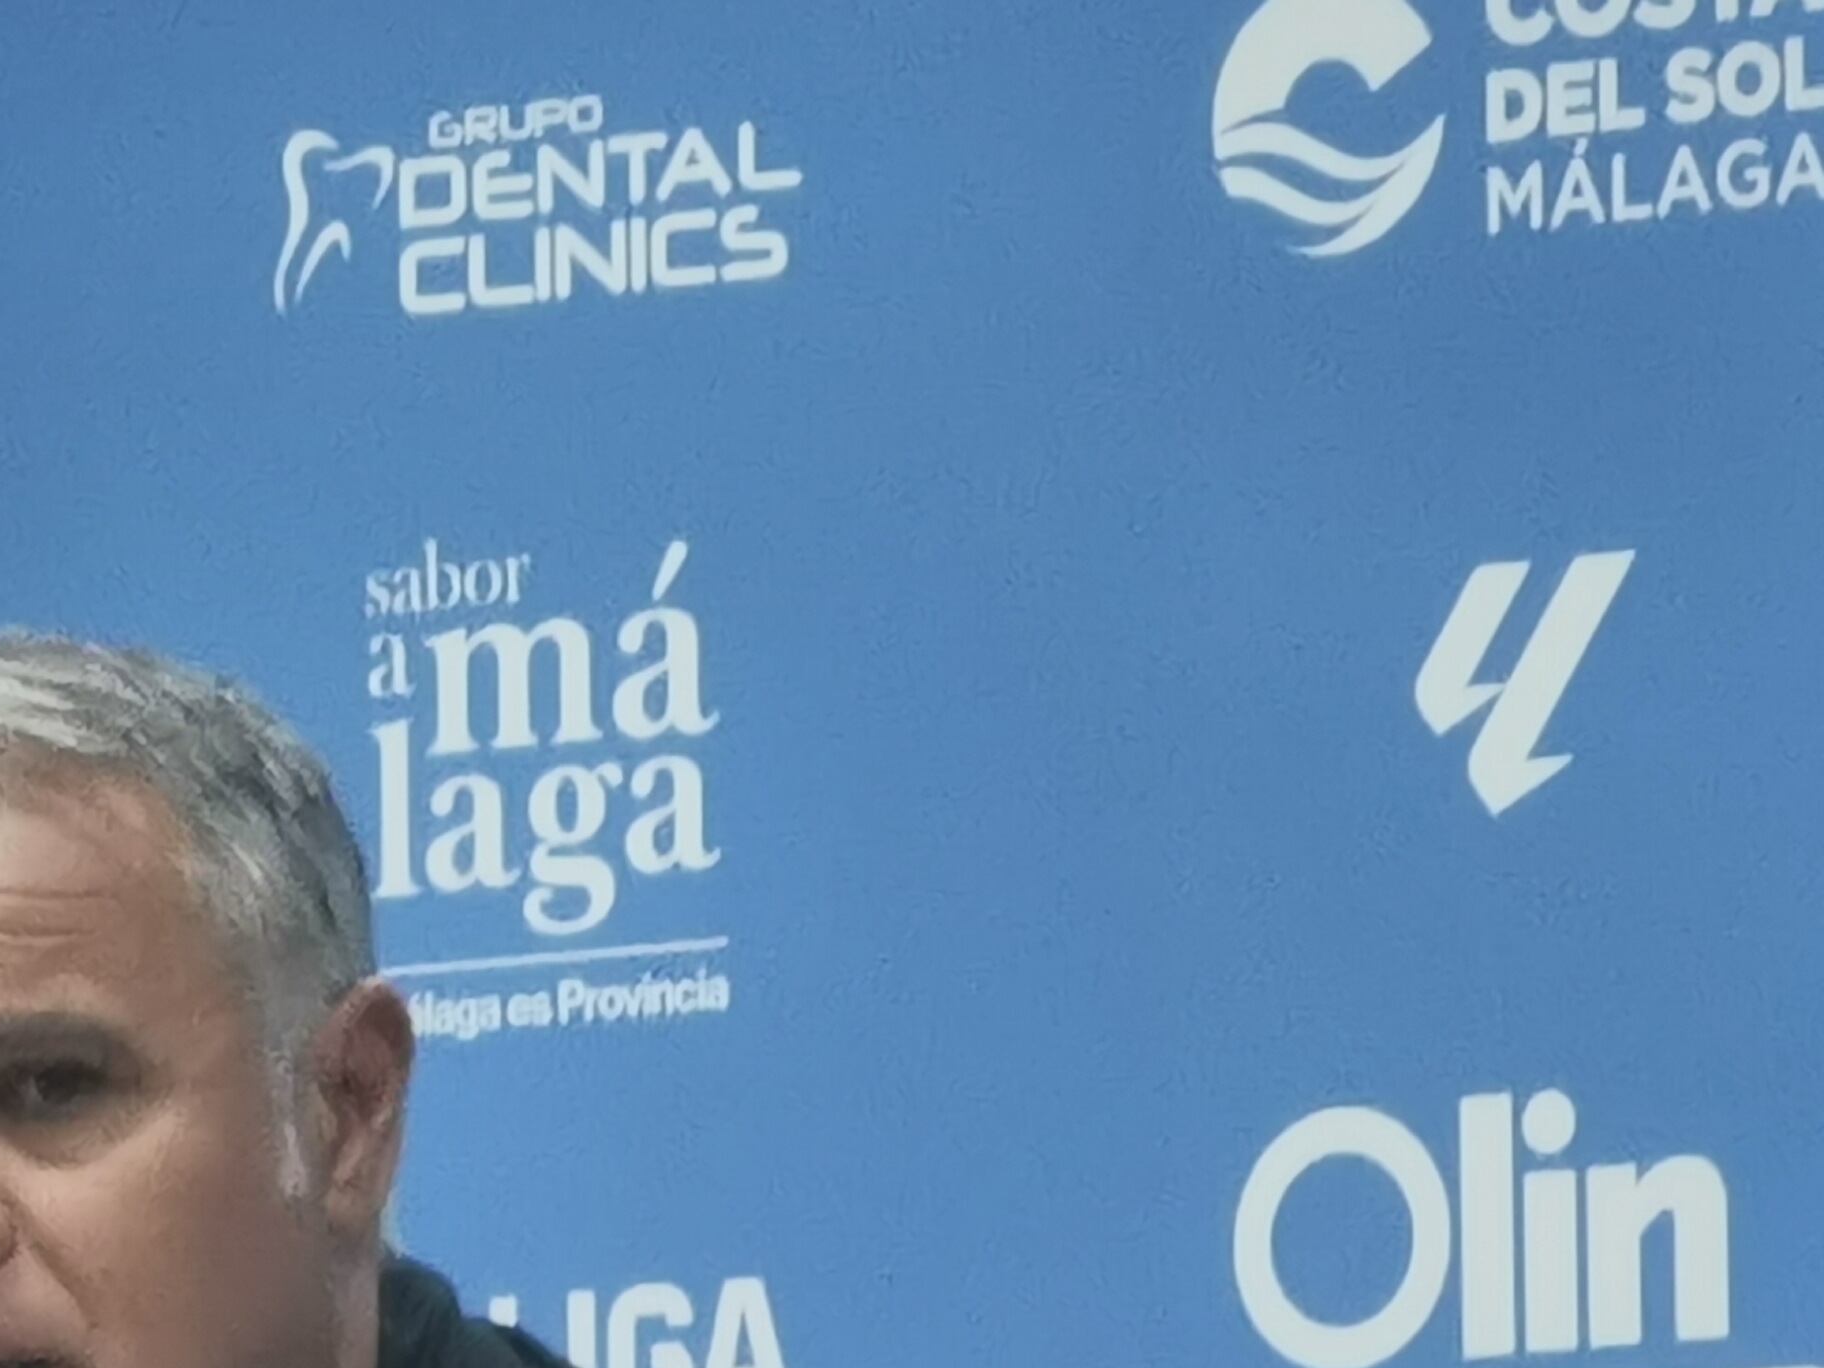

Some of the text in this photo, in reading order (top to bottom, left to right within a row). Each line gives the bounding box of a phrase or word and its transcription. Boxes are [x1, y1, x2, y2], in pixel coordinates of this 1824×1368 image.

[429, 94, 604, 149] GRUPO
[1486, 35, 1824, 145] DEL SOL
[398, 120, 804, 231] DENTAL
[1486, 131, 1824, 237] MÁLAGA
[398, 204, 790, 315] CLINICS
[365, 537, 531, 619] sabor
[367, 540, 721, 758] a má
[372, 717, 721, 936] laga
